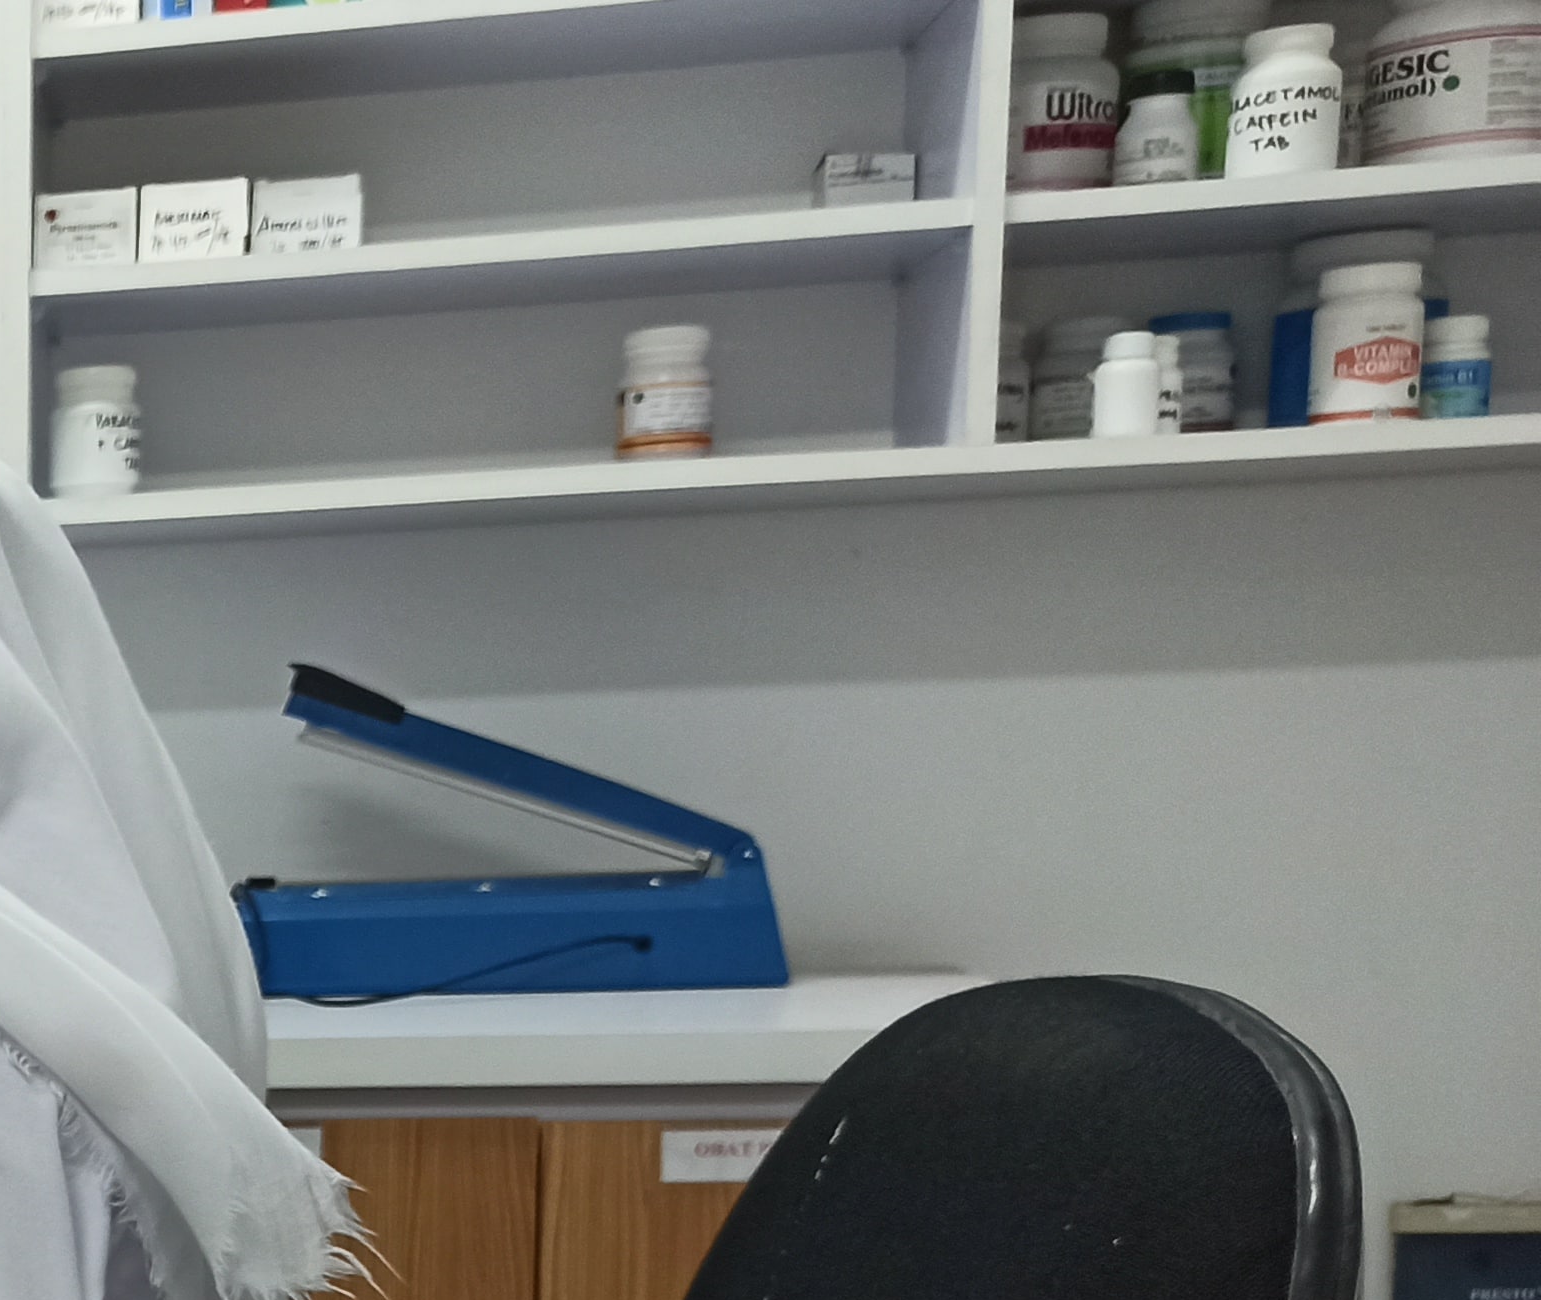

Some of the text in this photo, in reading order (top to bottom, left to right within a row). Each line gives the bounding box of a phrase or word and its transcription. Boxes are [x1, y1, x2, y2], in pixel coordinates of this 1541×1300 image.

[1249, 135, 1290, 152] TAB
[1354, 344, 1413, 362] VITAMIN
[1337, 358, 1417, 377] B-COMPLE
